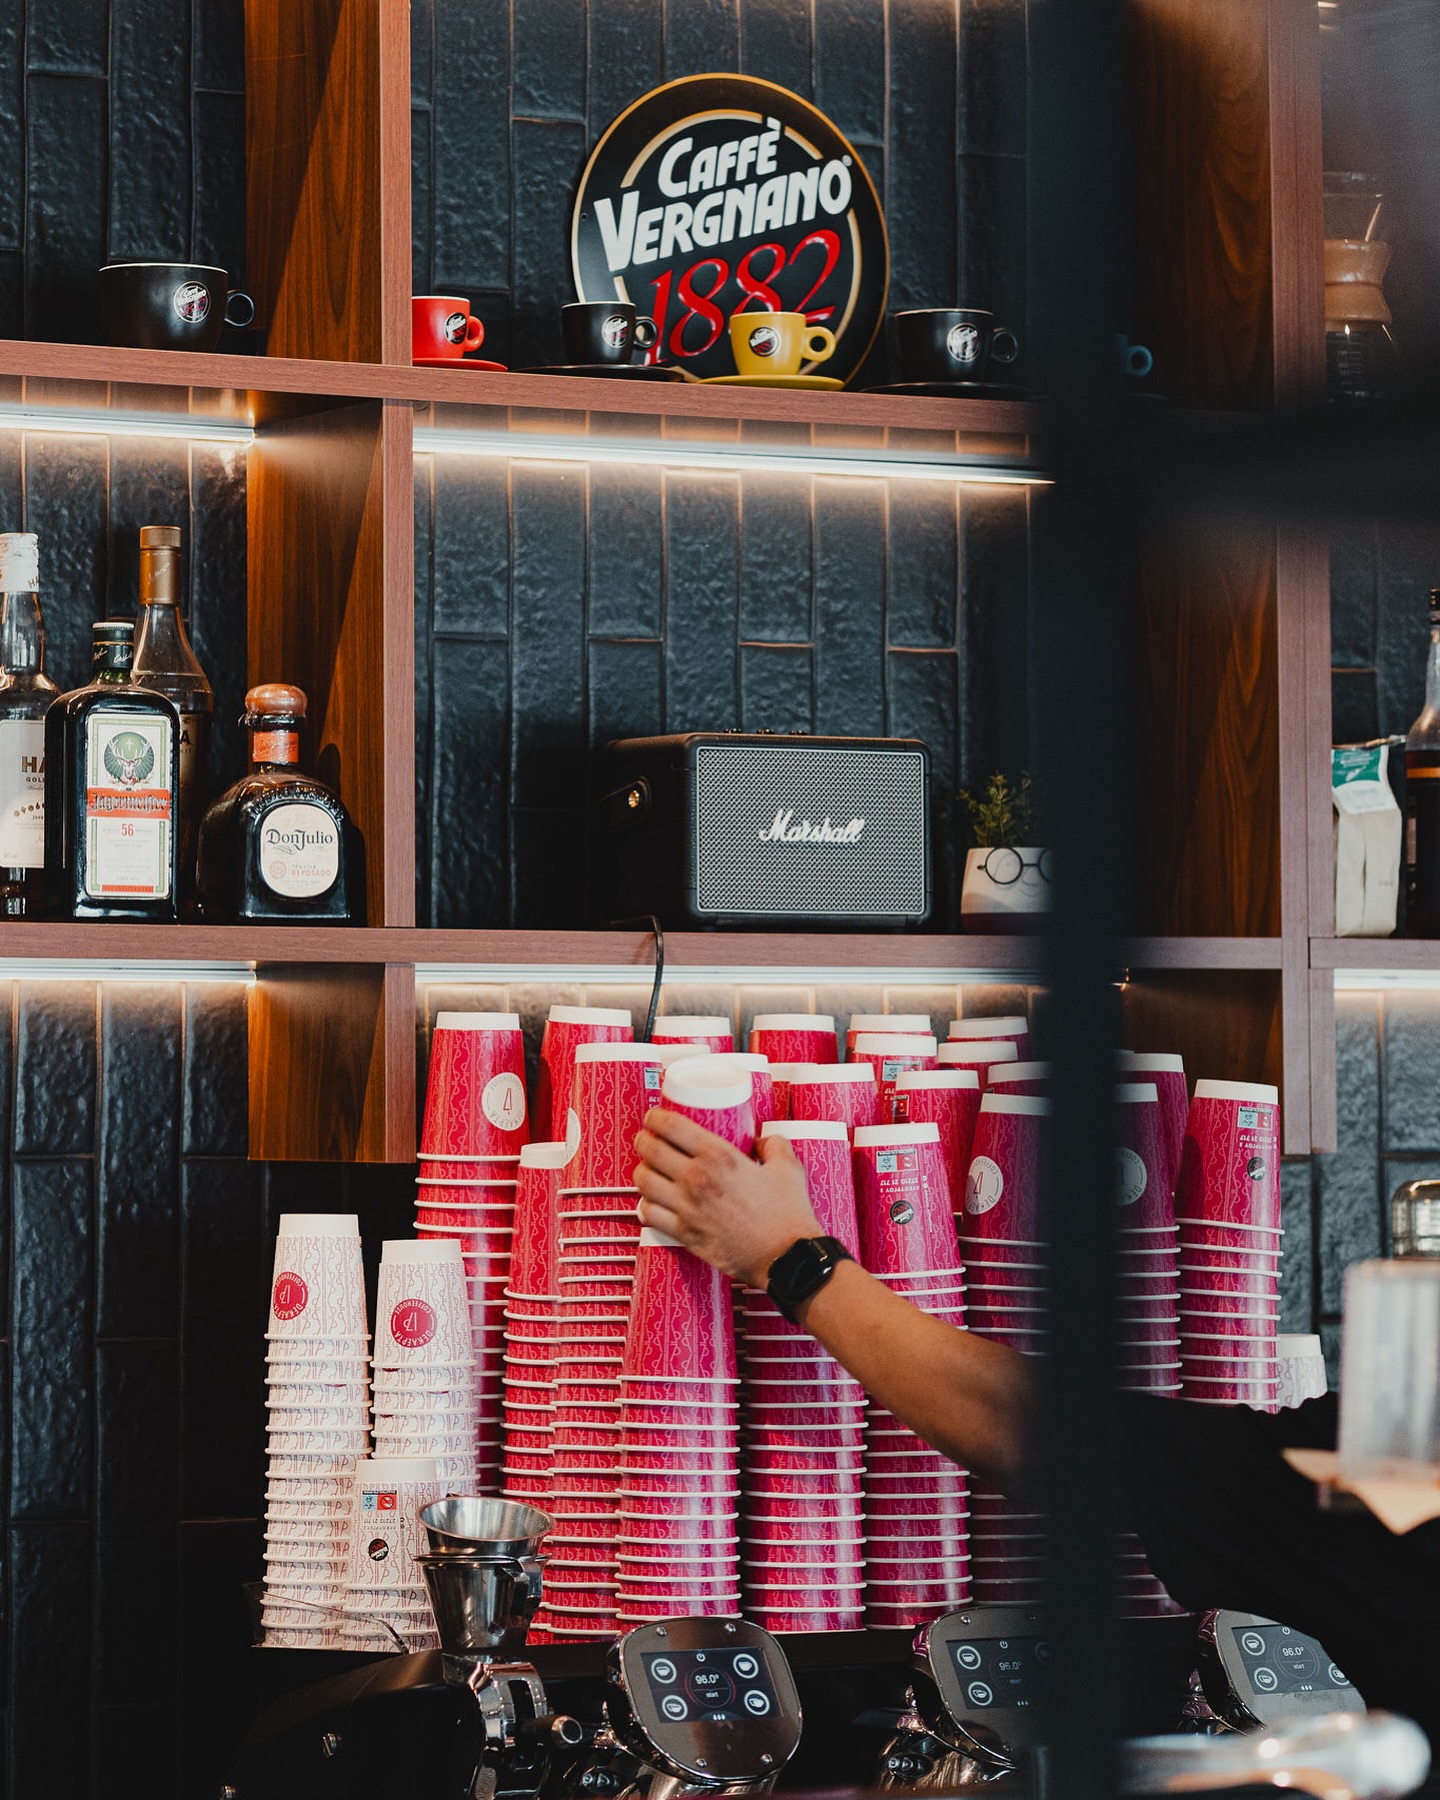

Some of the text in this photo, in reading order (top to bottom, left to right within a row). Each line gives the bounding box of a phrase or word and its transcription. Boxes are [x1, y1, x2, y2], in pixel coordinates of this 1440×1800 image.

[594, 160, 852, 272] VERGNANO
[644, 230, 840, 366] 1882
[122, 824, 134, 836] 56
[759, 808, 864, 842] Marshall
